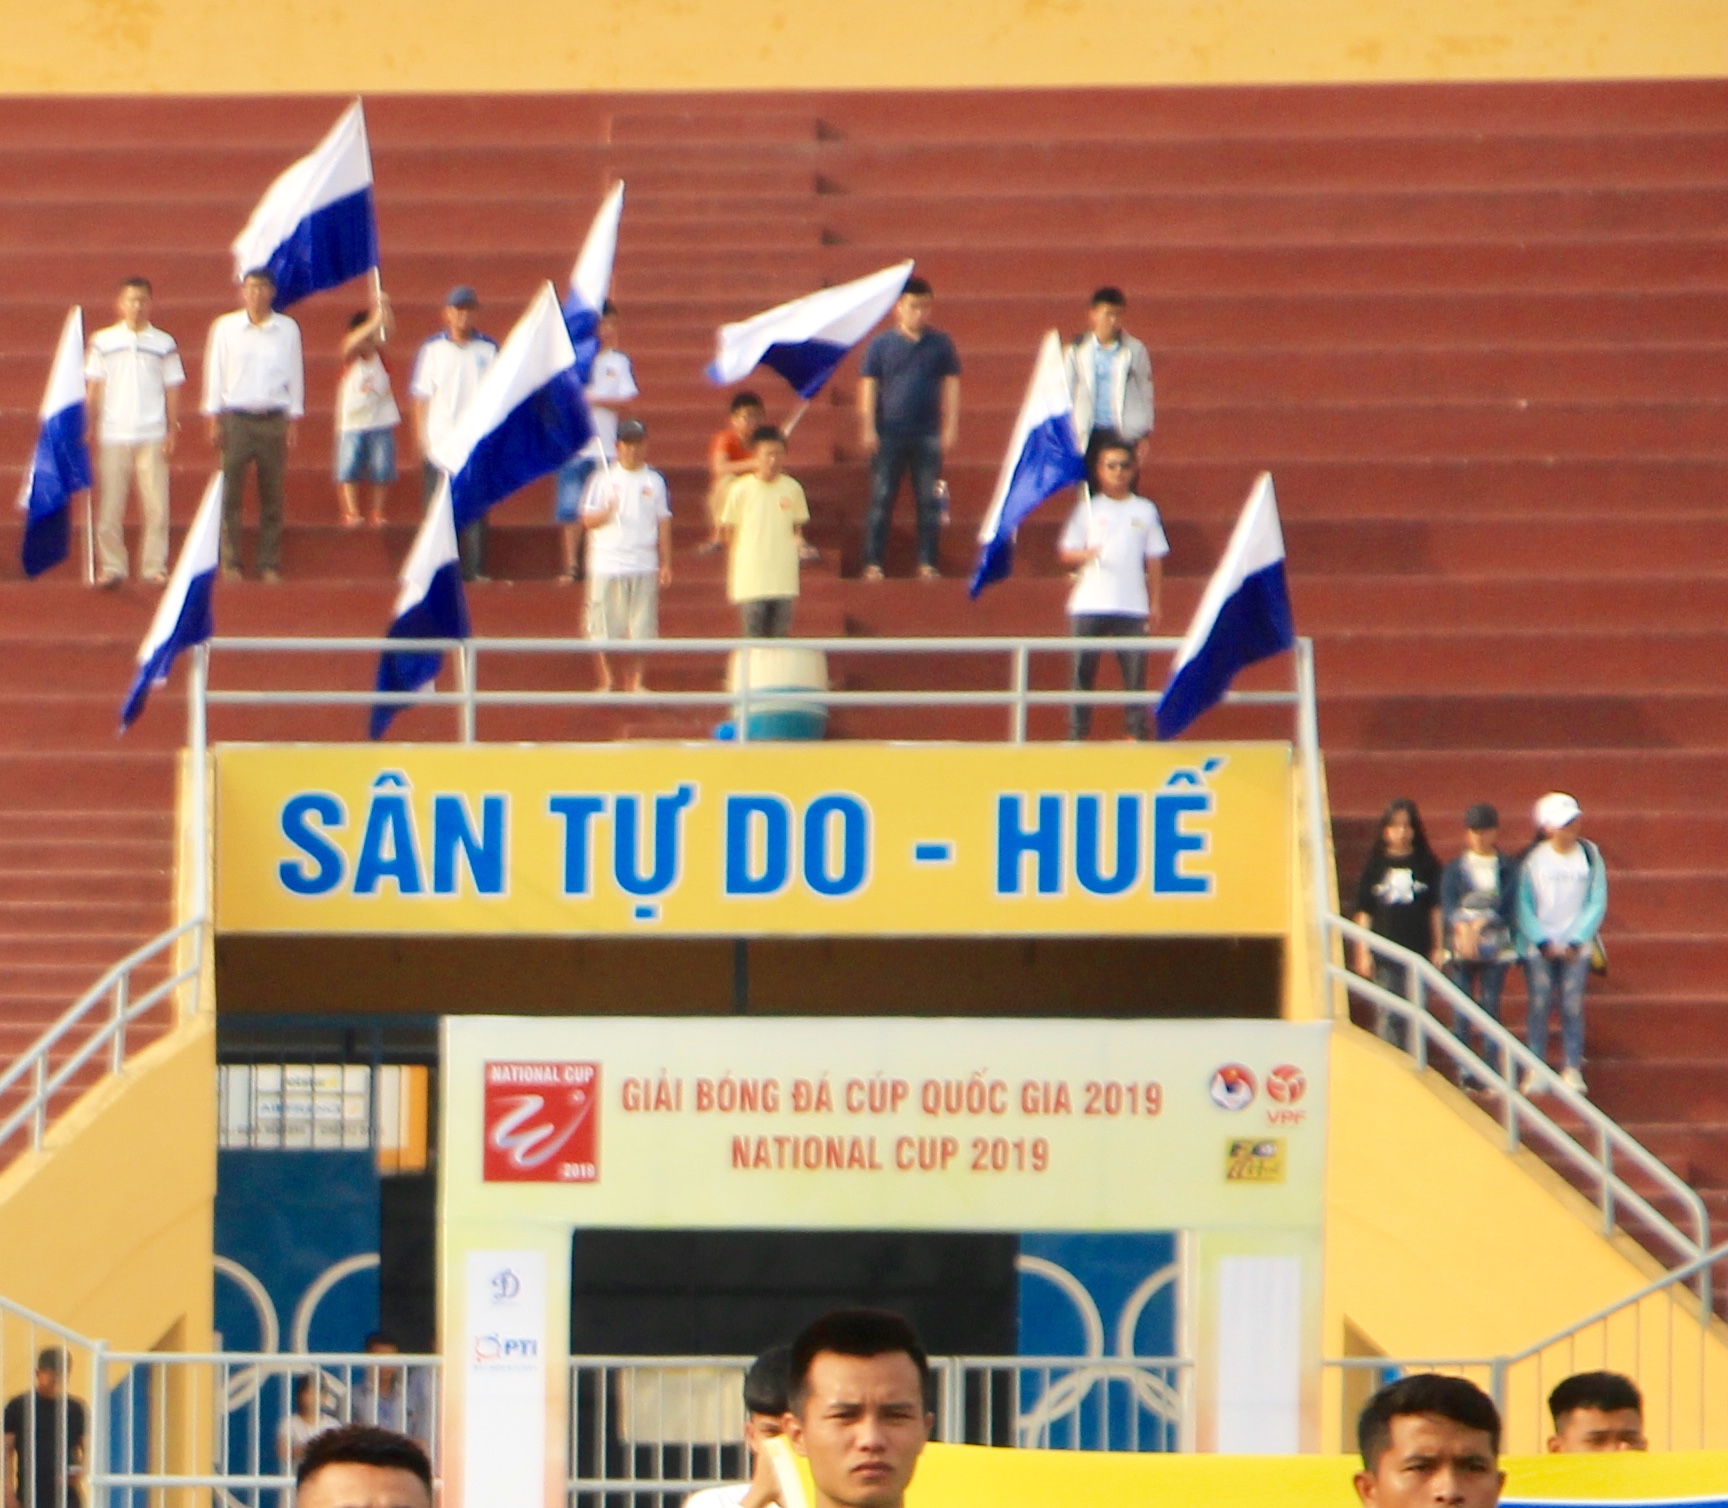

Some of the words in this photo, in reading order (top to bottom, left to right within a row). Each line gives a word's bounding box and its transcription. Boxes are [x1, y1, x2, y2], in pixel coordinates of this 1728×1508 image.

[278, 769, 504, 895] SÂN
[549, 783, 696, 919] TỰ
[726, 794, 870, 896] DO
[998, 757, 1224, 895] HUẾ
[492, 1065, 561, 1083] NATIONAL
[564, 1066, 594, 1083] CUP
[622, 1067, 683, 1113] GIẢI
[696, 1070, 781, 1113] BÓNG
[792, 1070, 835, 1113] ĐÁ
[846, 1070, 910, 1115] CÚP
[922, 1068, 1009, 1117] QUỐC
[1021, 1080, 1073, 1115] GIA
[1084, 1082, 1164, 1116] 2019
[732, 1135, 883, 1171] NATIONAL
[895, 1136, 960, 1171] CUP
[971, 1137, 1050, 1172] 2019
